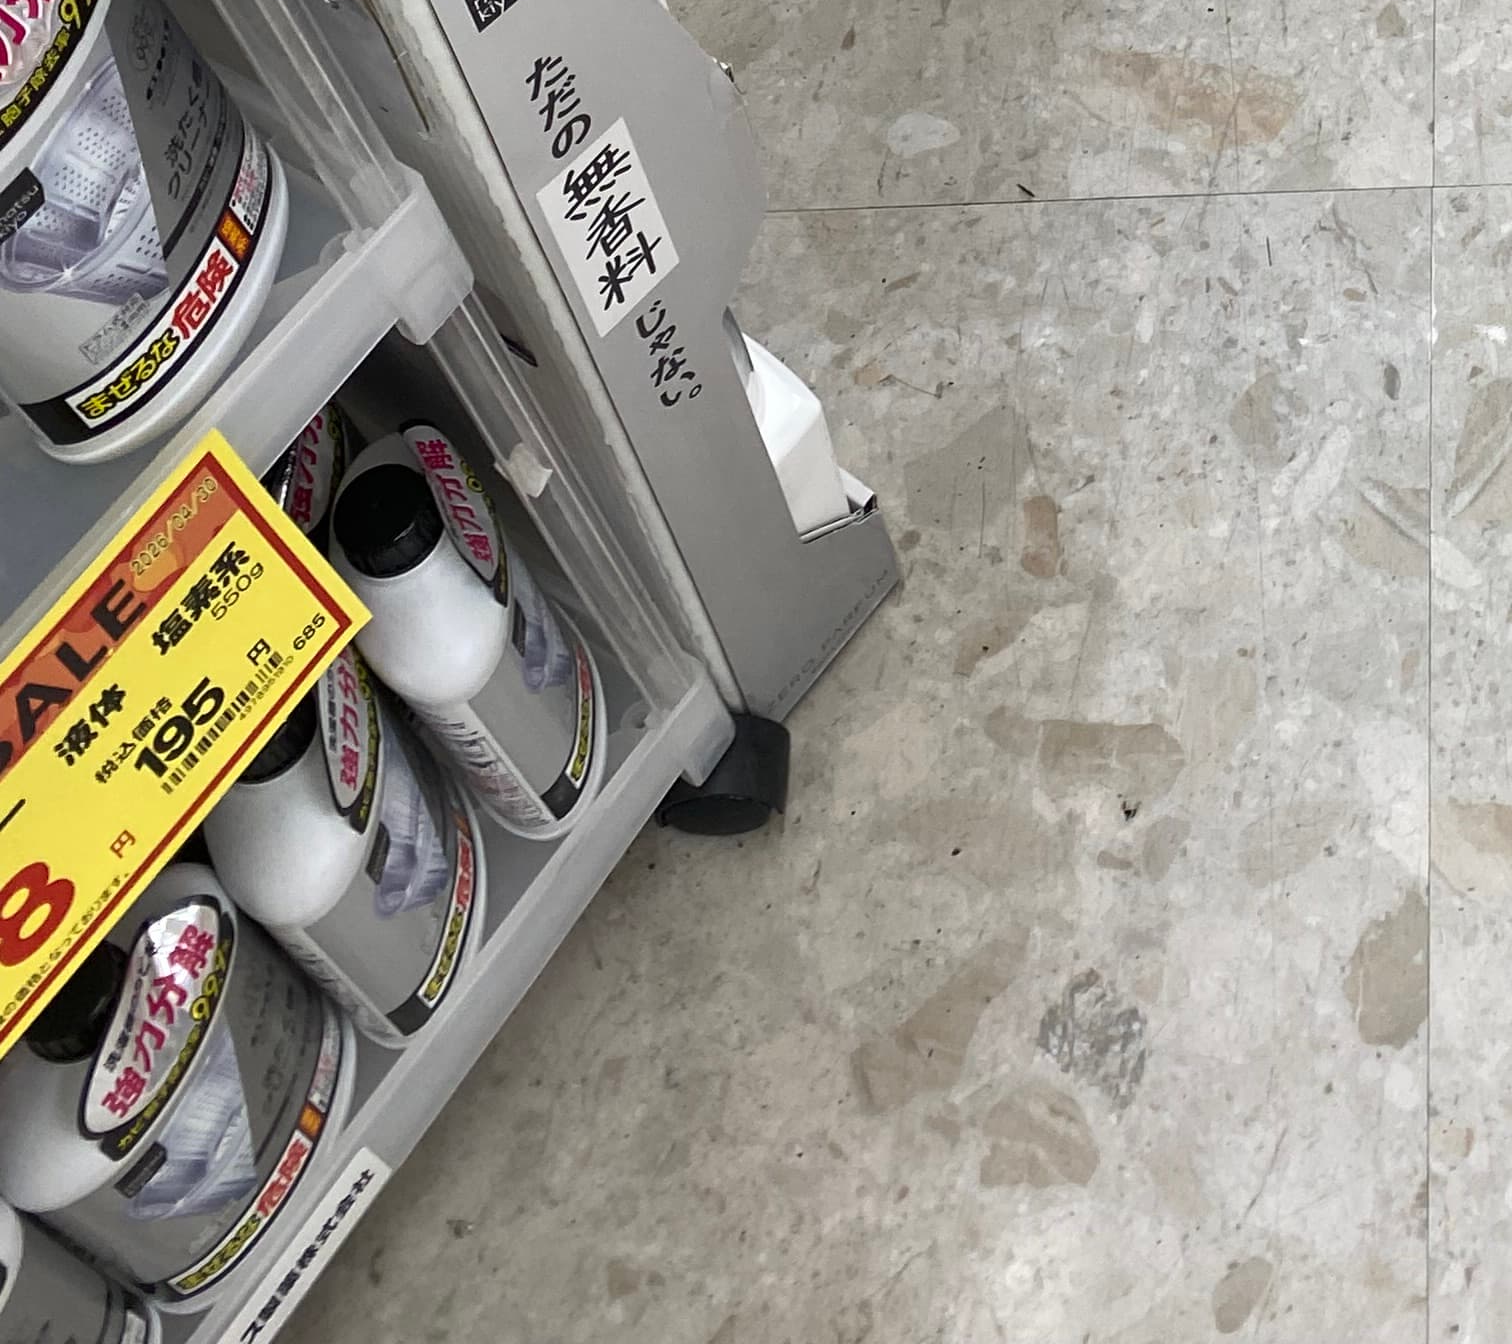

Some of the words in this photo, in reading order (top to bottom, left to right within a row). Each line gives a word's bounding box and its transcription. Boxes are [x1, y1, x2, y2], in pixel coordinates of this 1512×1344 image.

[525, 53, 591, 160] ただの
[562, 141, 663, 310] 無香料
[81, 248, 236, 420] まぜるな危険
[634, 298, 703, 408] じゃない。
[130, 475, 219, 577] 2026/04/30
[415, 438, 495, 567] 強力分解
[151, 541, 251, 657] 塩素系
[210, 561, 266, 623] 550g
[292, 612, 327, 652] 685
[54, 683, 127, 767] 液体
[95, 696, 174, 786] 税込価格
[134, 676, 226, 781] 195
[245, 637, 272, 667] 円
[335, 650, 362, 794] 強力分
[109, 829, 137, 860] 円
[101, 923, 218, 1119] 強力分解
[239, 1167, 376, 1344] ス製薬株式会社
